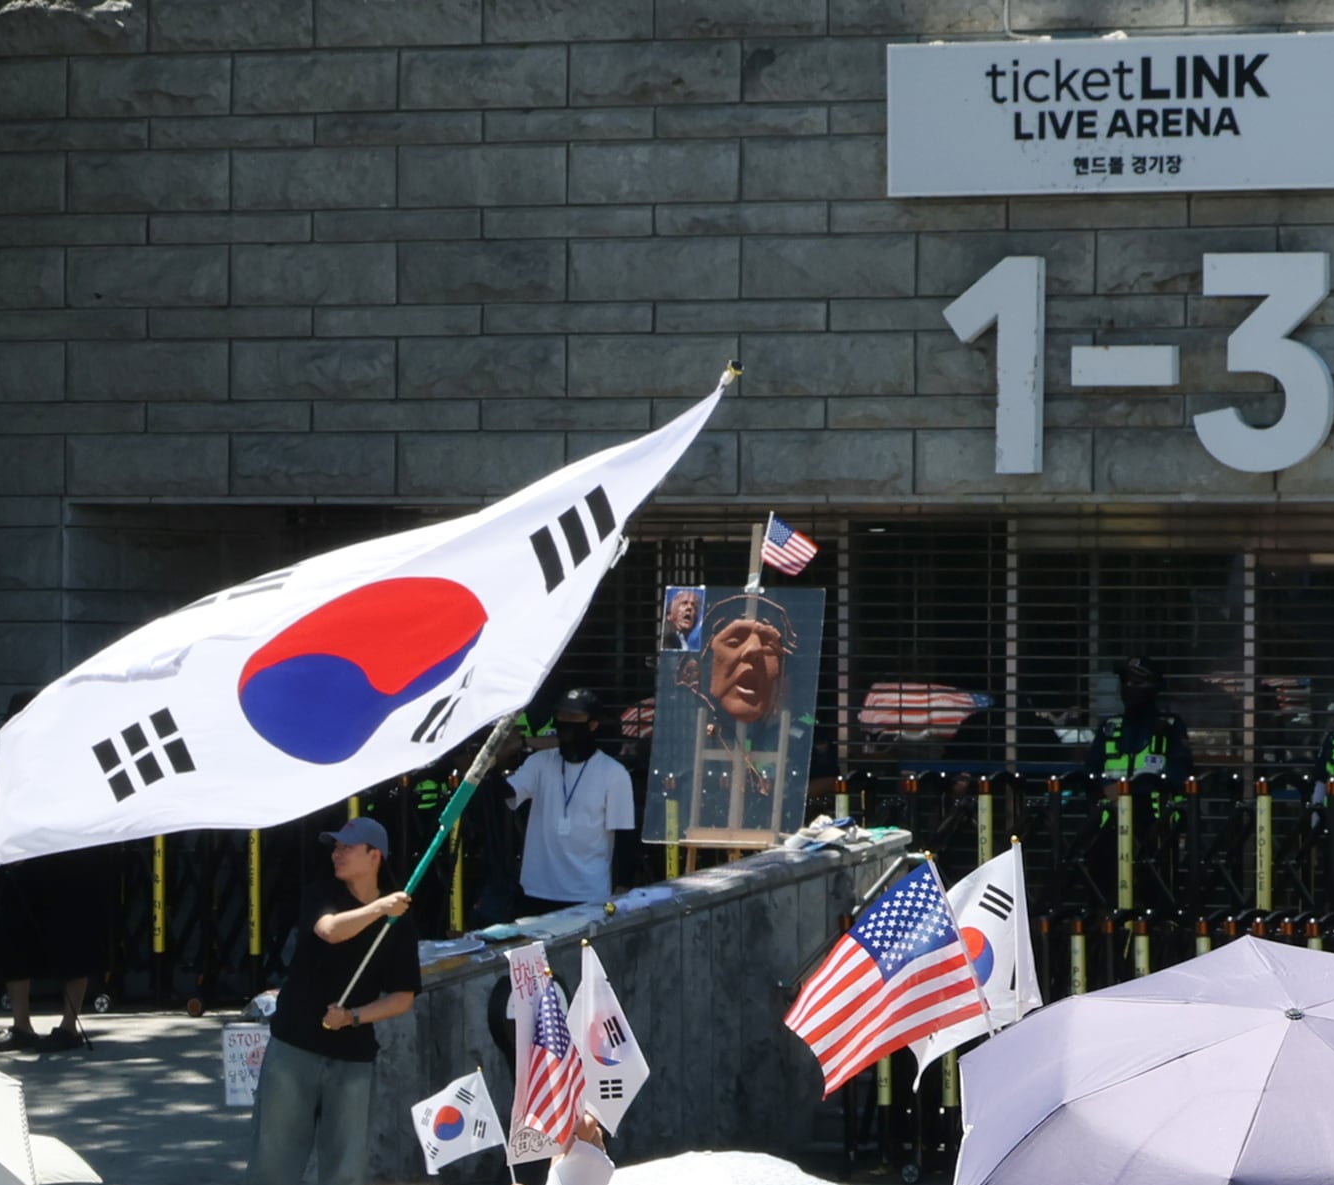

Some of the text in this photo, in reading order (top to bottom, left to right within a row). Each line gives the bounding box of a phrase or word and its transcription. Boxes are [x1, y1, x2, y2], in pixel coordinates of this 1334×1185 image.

[985, 53, 1270, 104] ticketLINK
[1014, 108, 1240, 141] LIVE ARENA
[1131, 154, 1182, 175] 경기장
[227, 1032, 261, 1047] STOP
